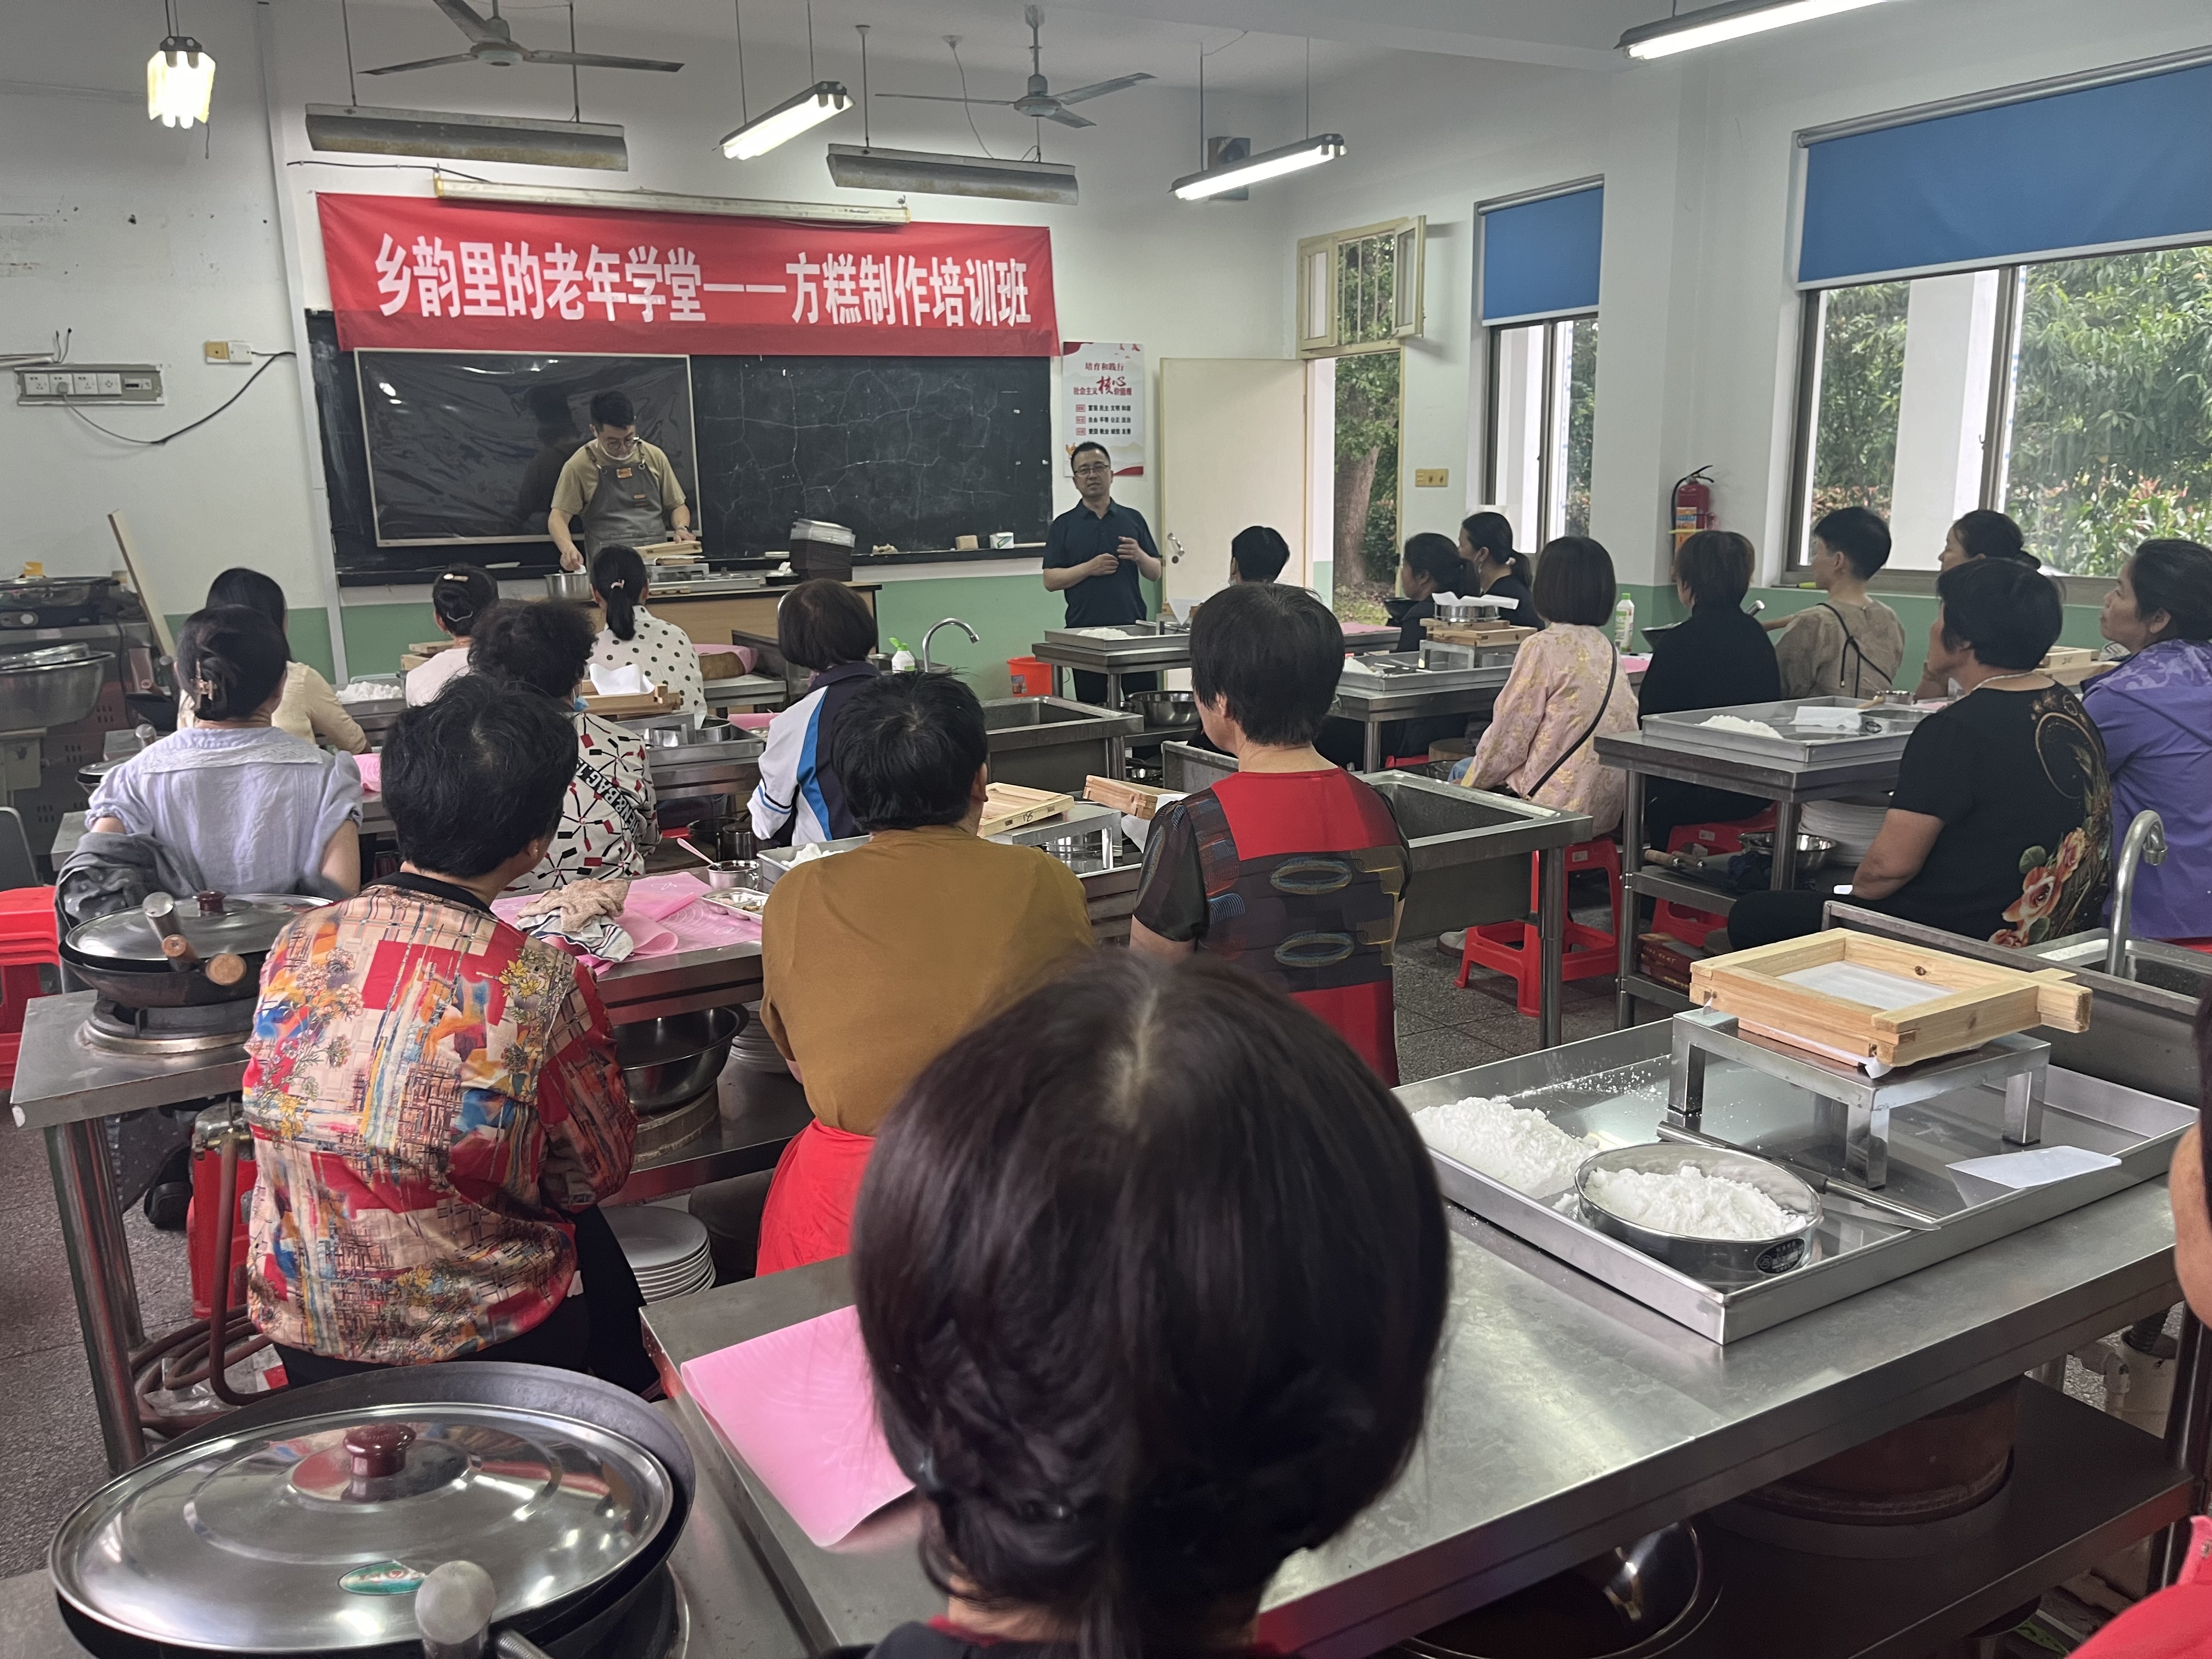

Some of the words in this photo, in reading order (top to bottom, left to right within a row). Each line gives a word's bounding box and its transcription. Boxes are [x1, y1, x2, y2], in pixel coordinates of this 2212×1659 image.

[375, 233, 1031, 327] 乡韵里的老年学堂——方糕制作培训班
[1023, 810, 1033, 822] 18
